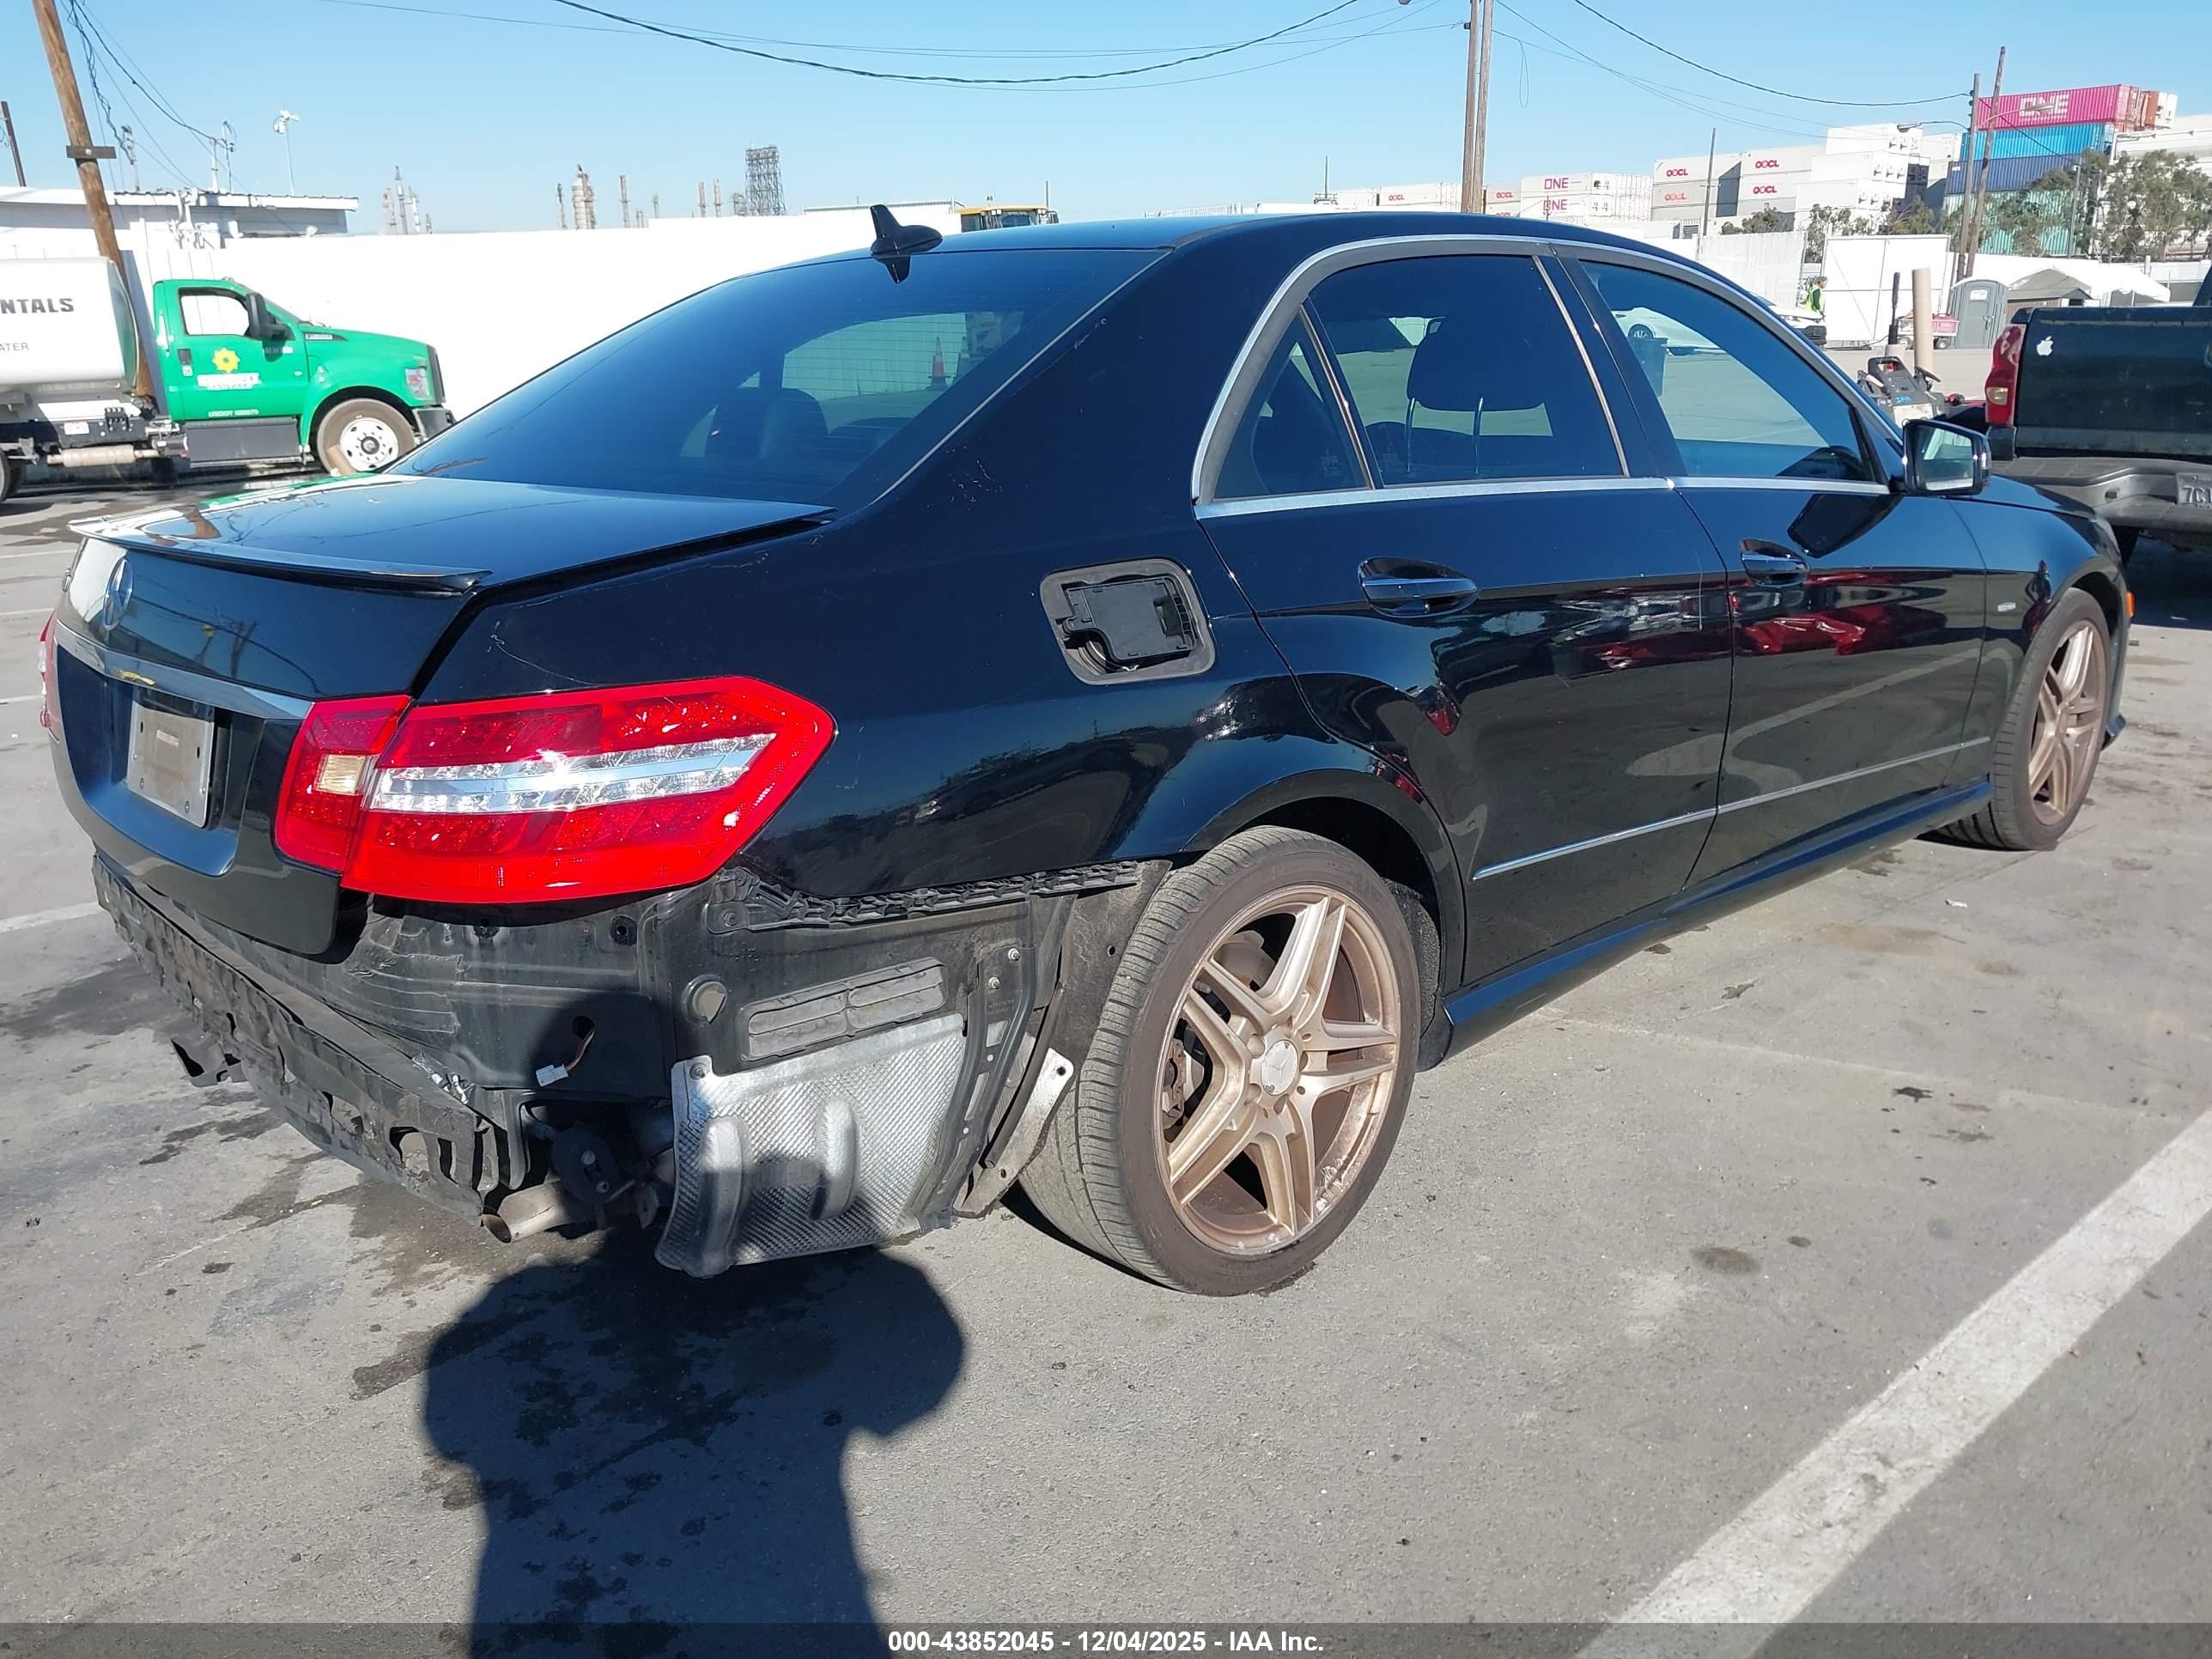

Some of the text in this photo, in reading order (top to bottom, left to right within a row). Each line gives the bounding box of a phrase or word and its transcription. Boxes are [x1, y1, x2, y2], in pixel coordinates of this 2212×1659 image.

[1755, 160, 1779, 168] OOCL
[1544, 177, 1569, 190] ONE
[1753, 185, 1777, 194] OOCL
[1543, 199, 1567, 211] ONE
